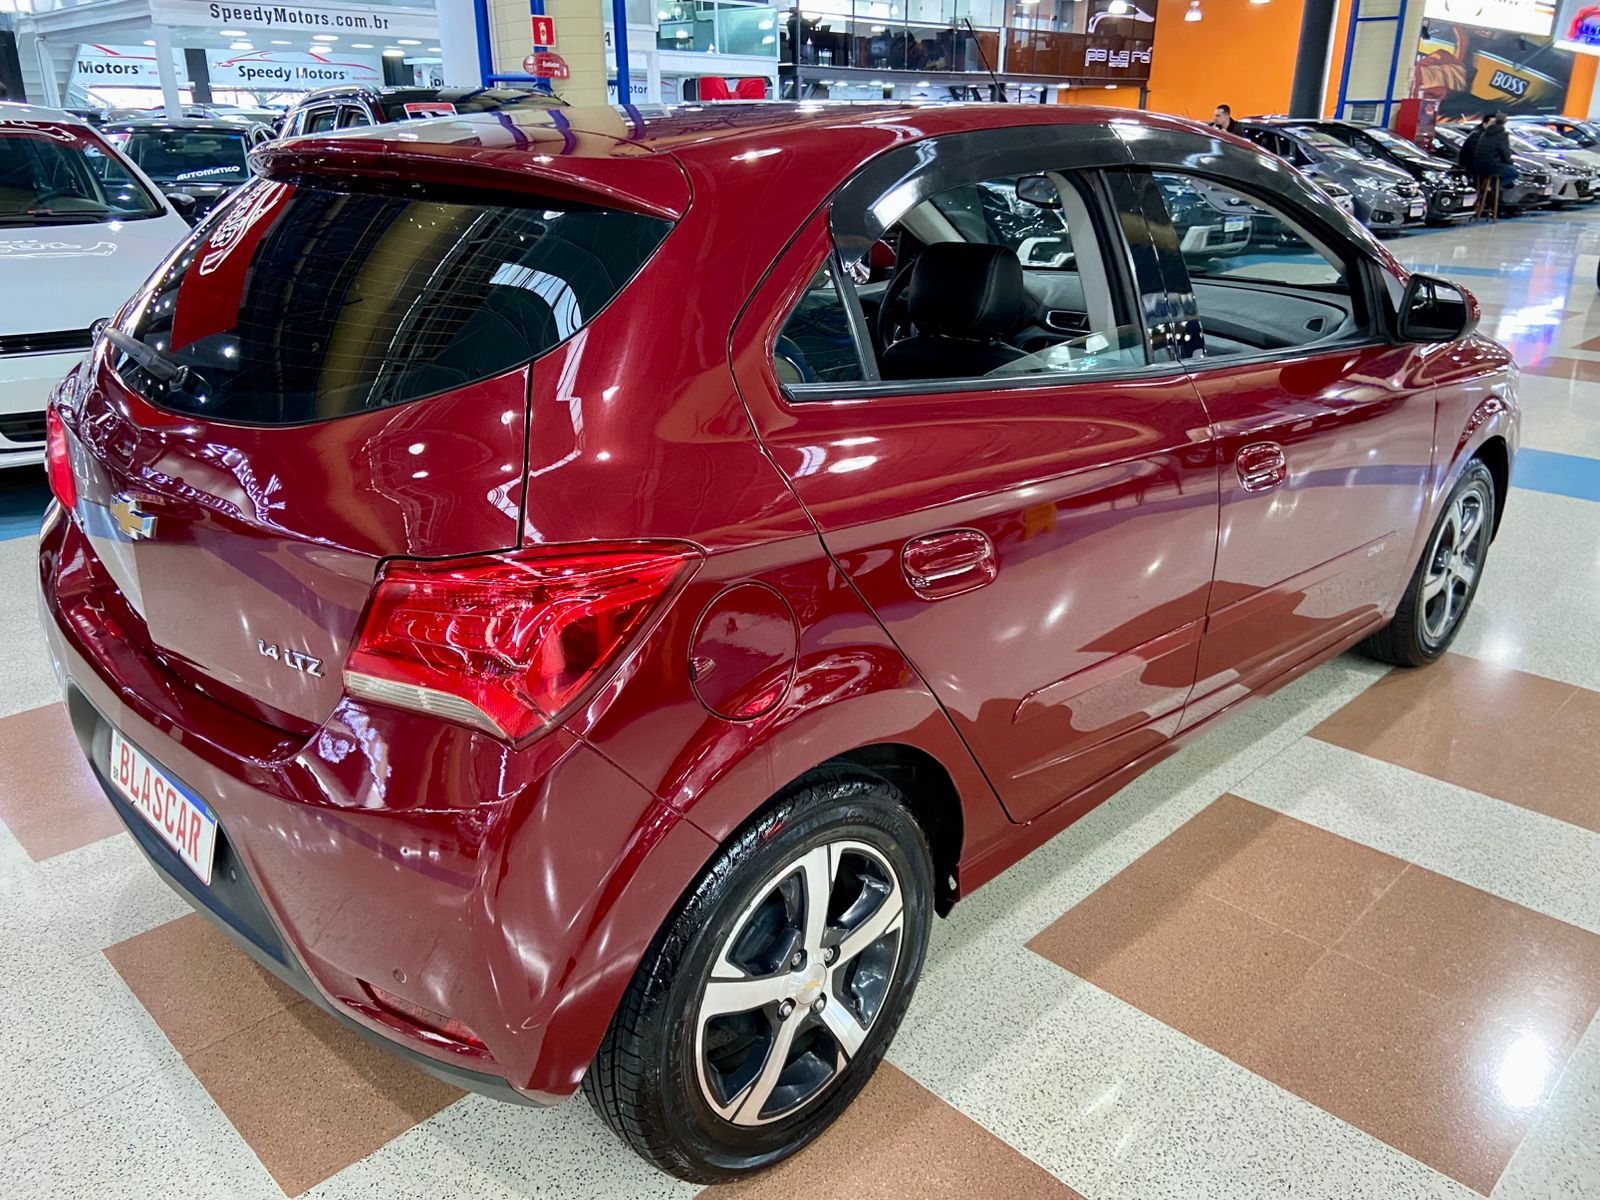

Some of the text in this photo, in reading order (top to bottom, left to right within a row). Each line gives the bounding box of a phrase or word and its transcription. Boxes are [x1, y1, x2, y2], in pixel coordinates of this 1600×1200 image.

[209, 3, 389, 30] SpeedyMotors.com.br
[78, 60, 139, 75] Motors
[238, 65, 292, 82] Speedy
[1491, 71, 1528, 95] BOSS
[284, 648, 322, 678] LTZ
[119, 742, 202, 863] BLASCAR
